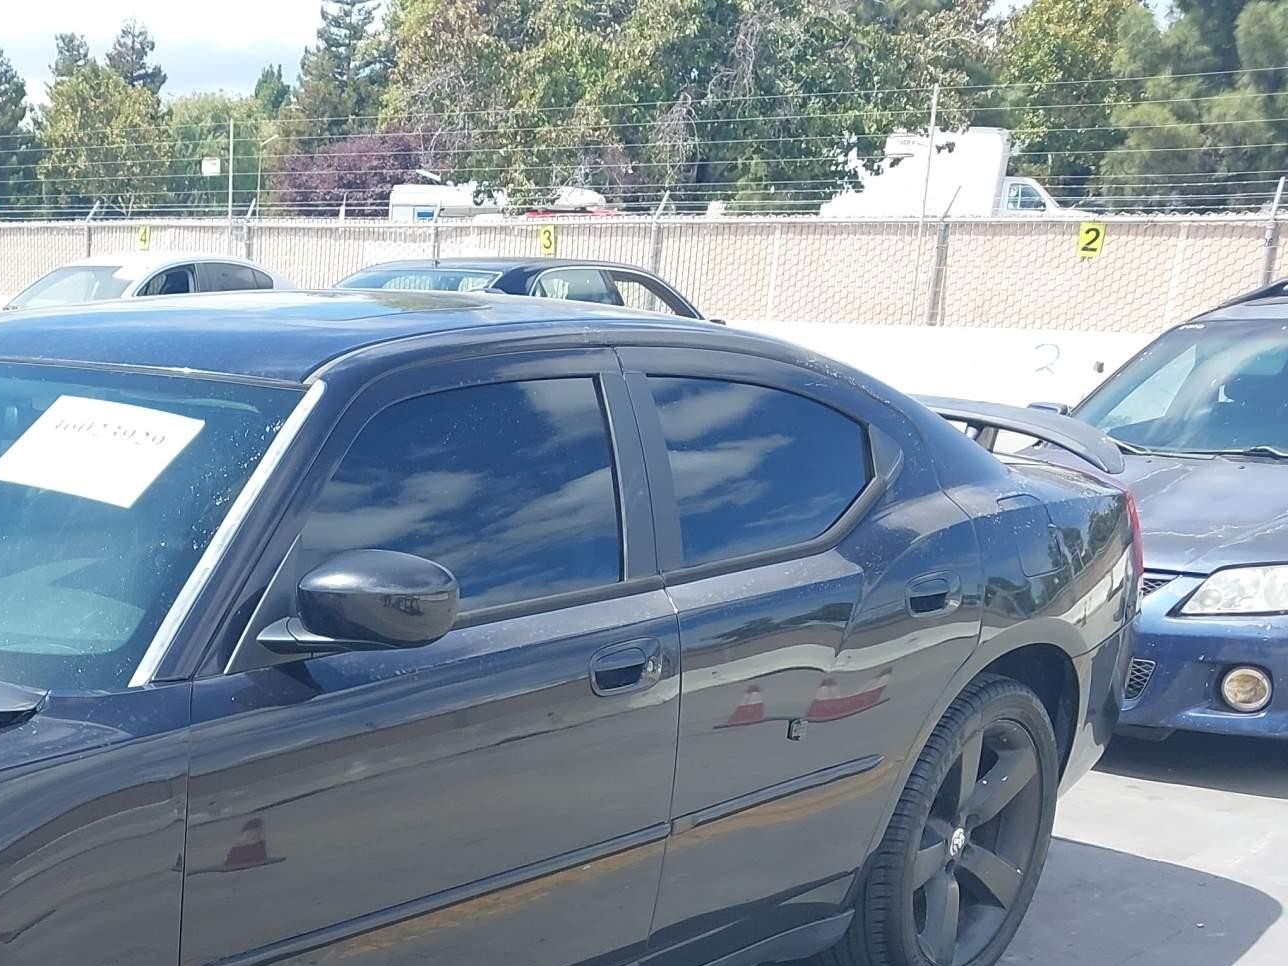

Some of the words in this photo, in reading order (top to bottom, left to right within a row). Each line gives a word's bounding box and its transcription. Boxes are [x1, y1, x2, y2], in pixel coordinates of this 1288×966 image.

[140, 226, 147, 245] 4
[543, 229, 552, 249] 3
[1081, 227, 1100, 252] 2
